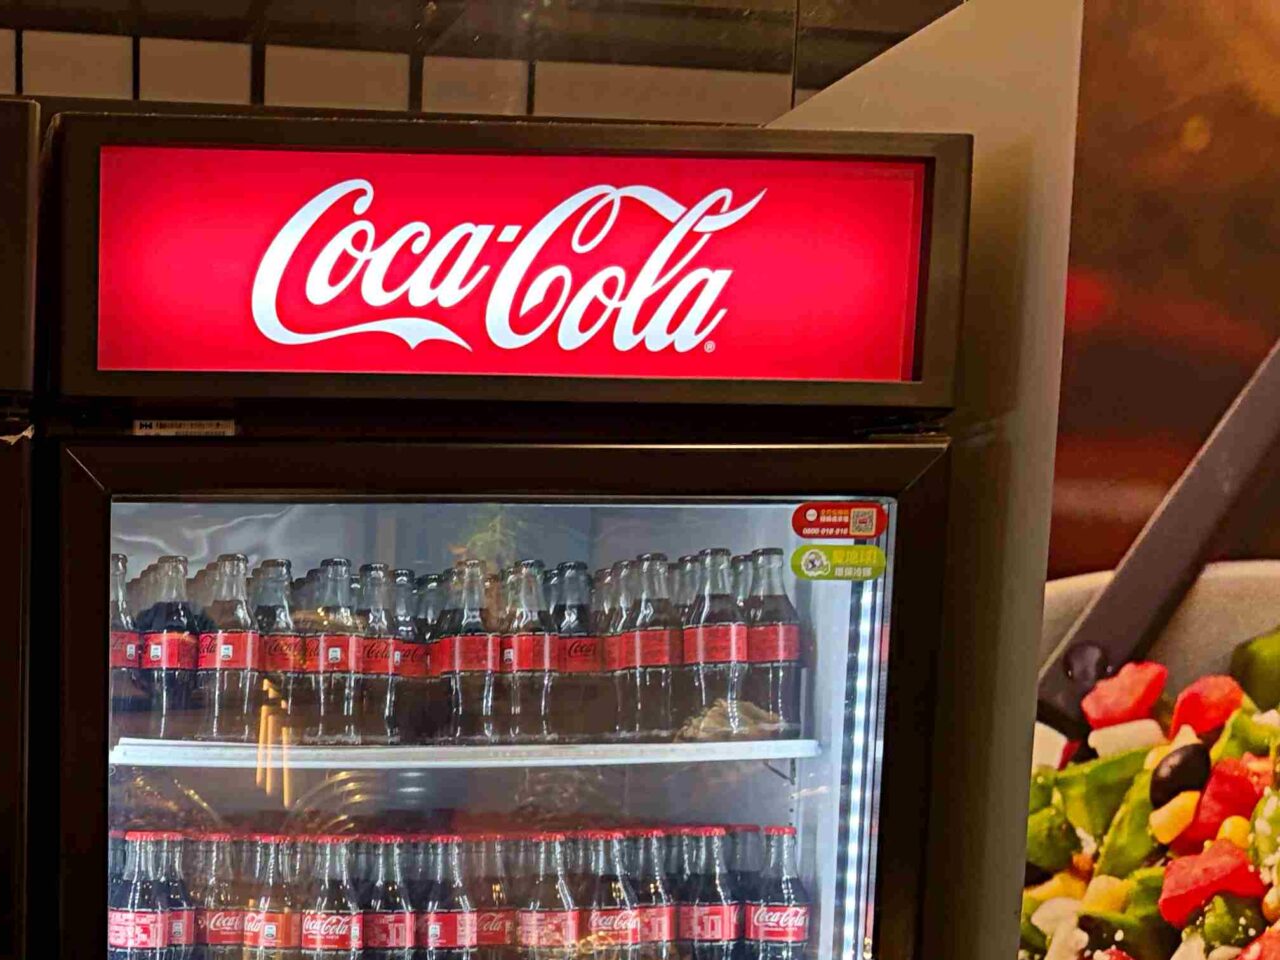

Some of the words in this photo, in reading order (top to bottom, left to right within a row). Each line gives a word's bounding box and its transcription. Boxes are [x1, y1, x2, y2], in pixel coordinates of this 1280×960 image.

[252, 179, 767, 352] Coca-Cola
[303, 914, 351, 935] Coca-Cola
[754, 906, 807, 927] Coca-Cola
